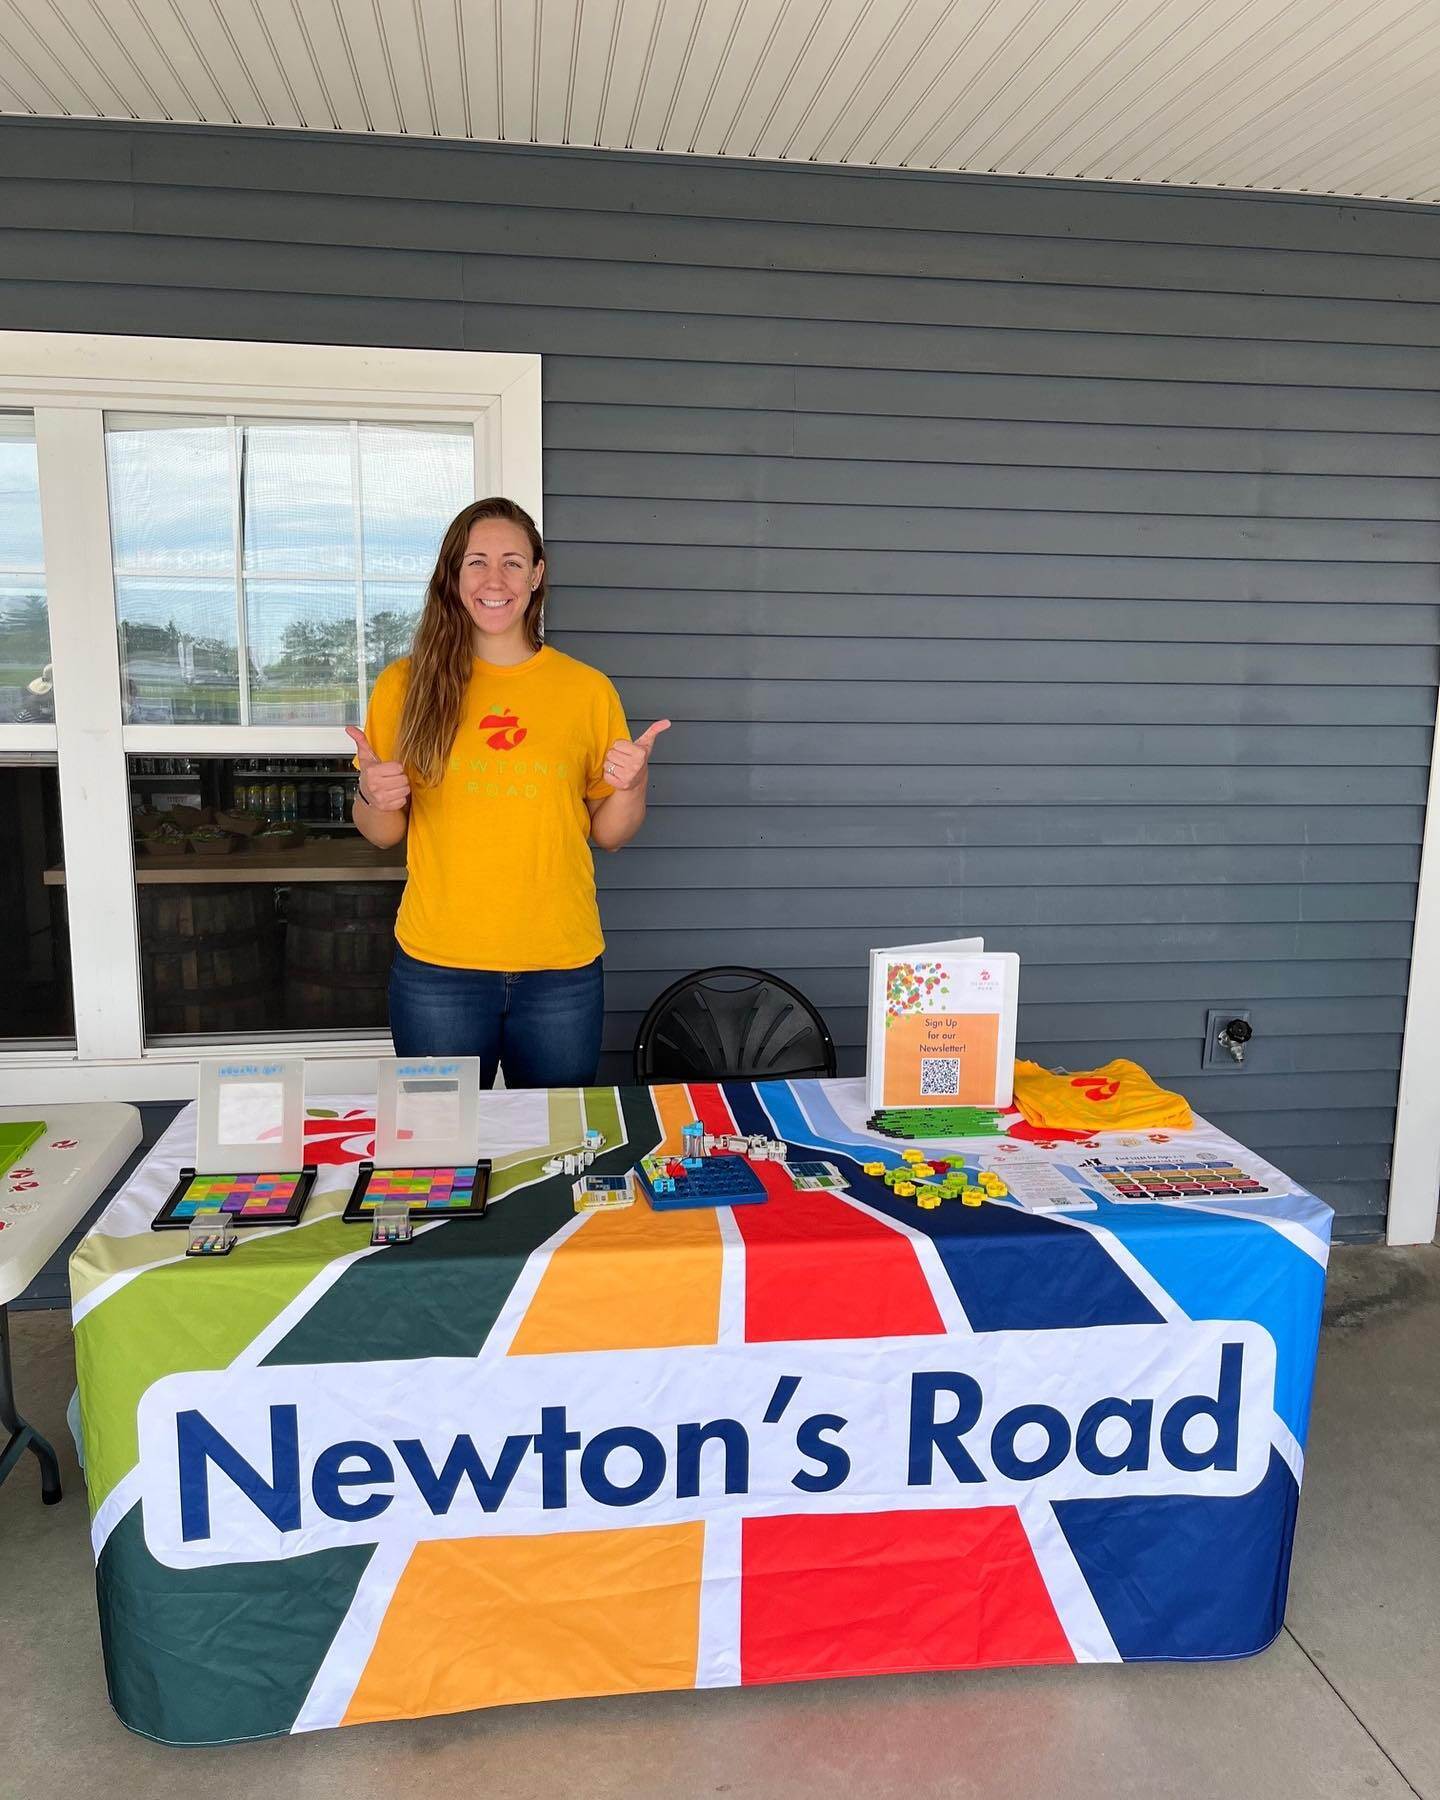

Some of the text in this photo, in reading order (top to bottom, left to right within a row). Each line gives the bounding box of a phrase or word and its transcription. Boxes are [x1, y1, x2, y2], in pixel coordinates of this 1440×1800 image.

[449, 757, 569, 779] EWTONS
[466, 782, 538, 799] ROAD
[925, 1018, 958, 1029] Sign Up
[928, 1030, 939, 1039] for
[919, 1043, 966, 1052] Newsletter!
[176, 1341, 1244, 1543] Newton's Road
